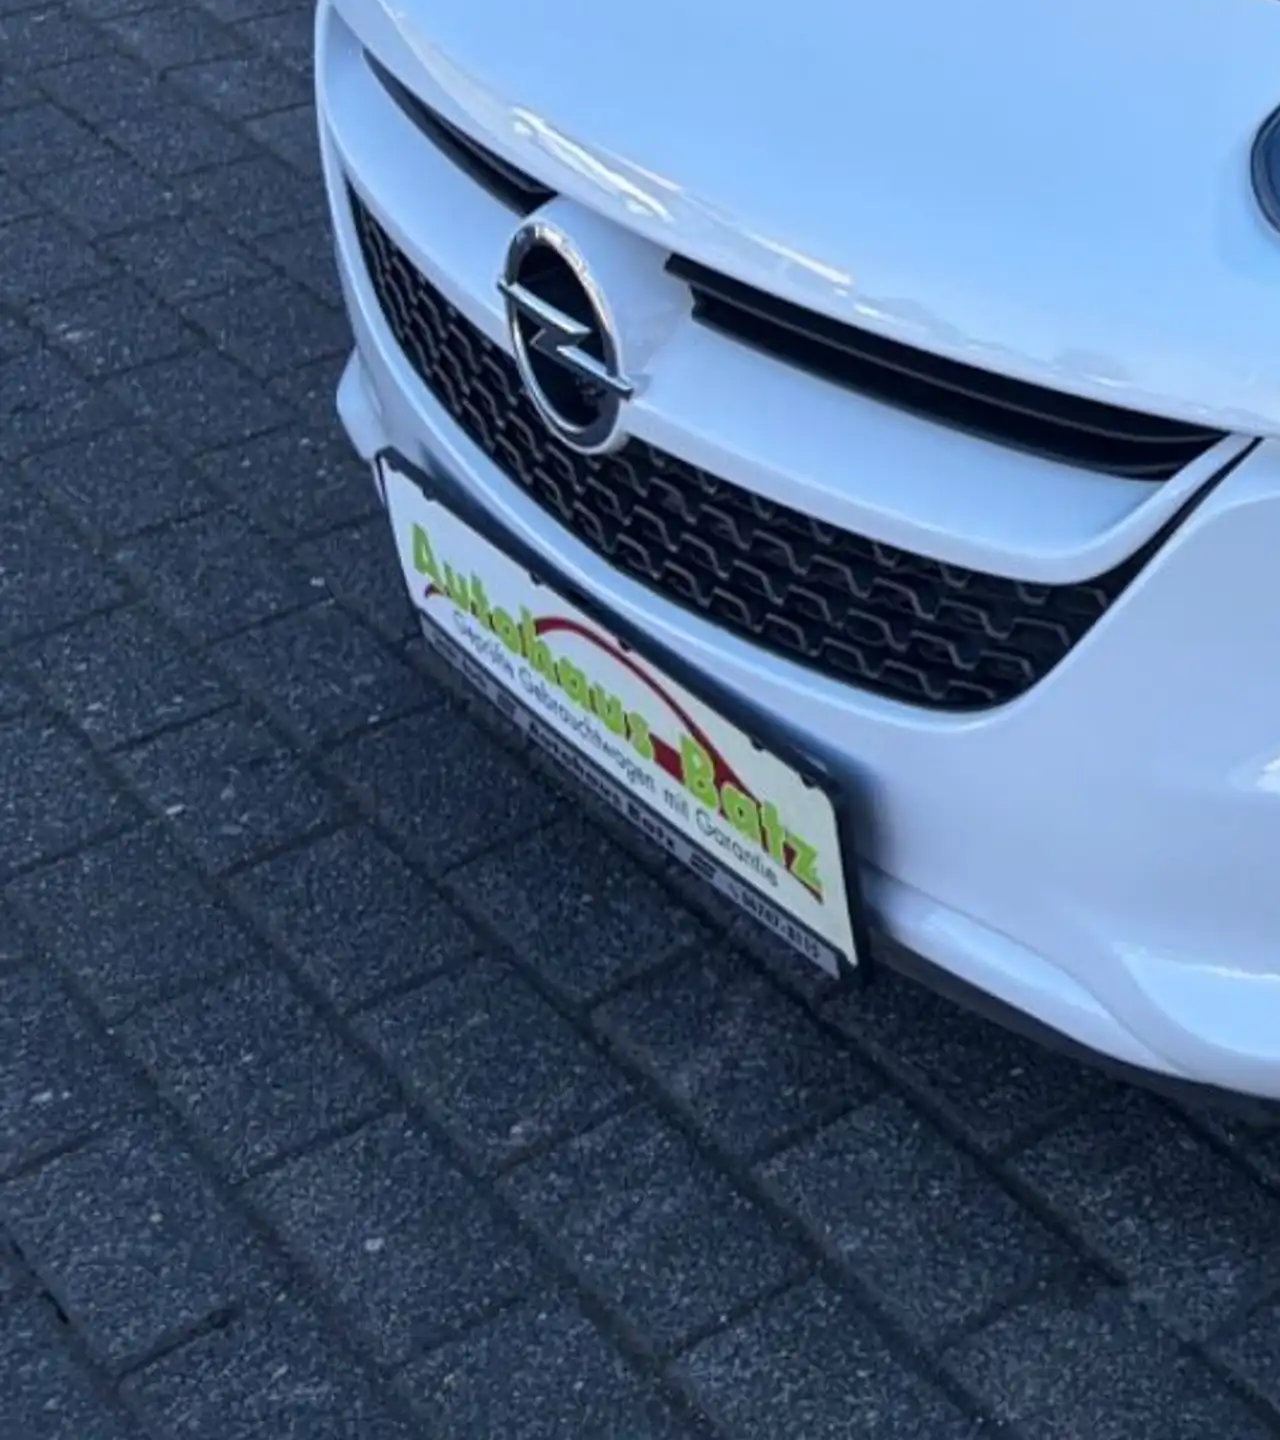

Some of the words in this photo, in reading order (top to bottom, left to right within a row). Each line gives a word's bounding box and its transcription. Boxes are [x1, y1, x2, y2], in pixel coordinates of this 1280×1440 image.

[411, 523, 653, 761] Autohaus
[679, 732, 824, 894] Batz
[518, 666, 657, 794] Gebrauchtwagen
[664, 788, 690, 822] mit
[695, 807, 780, 888] Garantie
